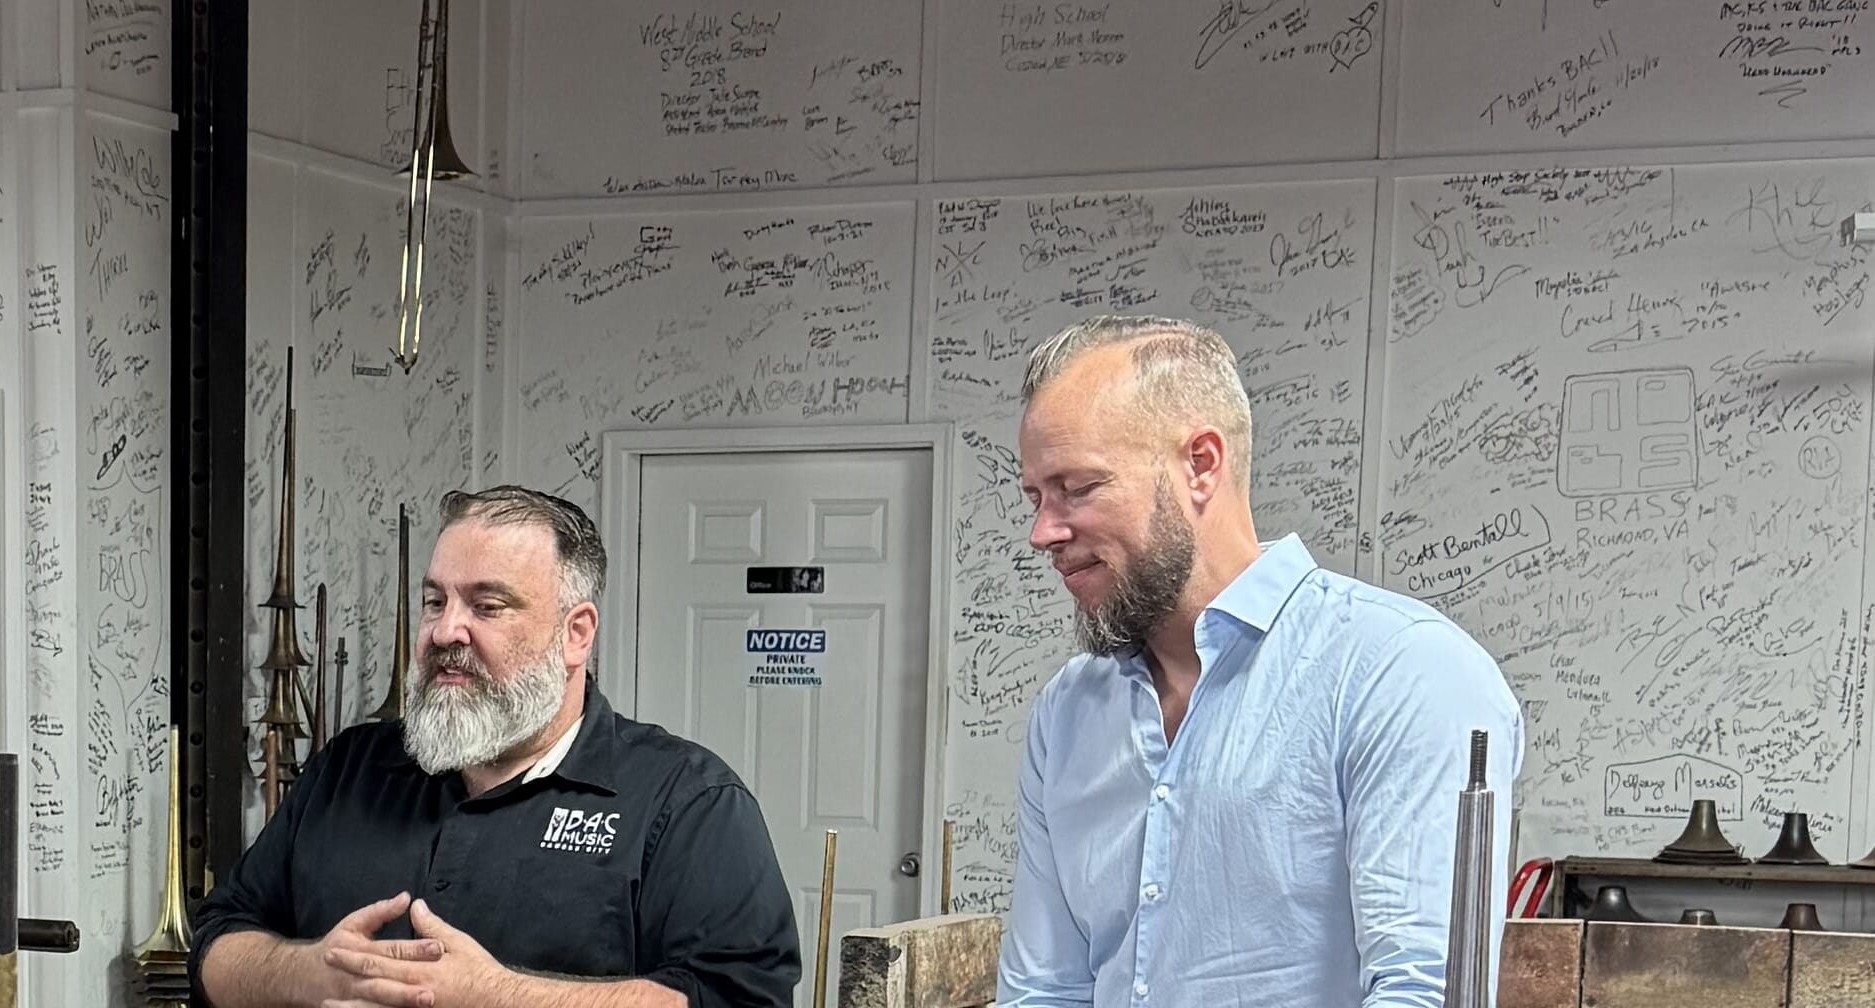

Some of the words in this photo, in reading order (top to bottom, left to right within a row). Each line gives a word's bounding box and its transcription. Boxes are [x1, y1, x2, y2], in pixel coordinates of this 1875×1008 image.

[1480, 76, 1556, 125] Thanks
[1575, 491, 1691, 525] BRASS
[1663, 519, 1689, 541] VA
[1390, 541, 1441, 576] Scott
[1408, 565, 1472, 593] Chicago
[749, 632, 824, 650] NOTICE
[766, 654, 806, 665] PRIVATE
[756, 666, 786, 675] PLEASE
[787, 666, 815, 675] KNOCK
[749, 676, 781, 685] BEFORE
[782, 676, 822, 686] ENTERING
[561, 831, 614, 848] MUSIC
